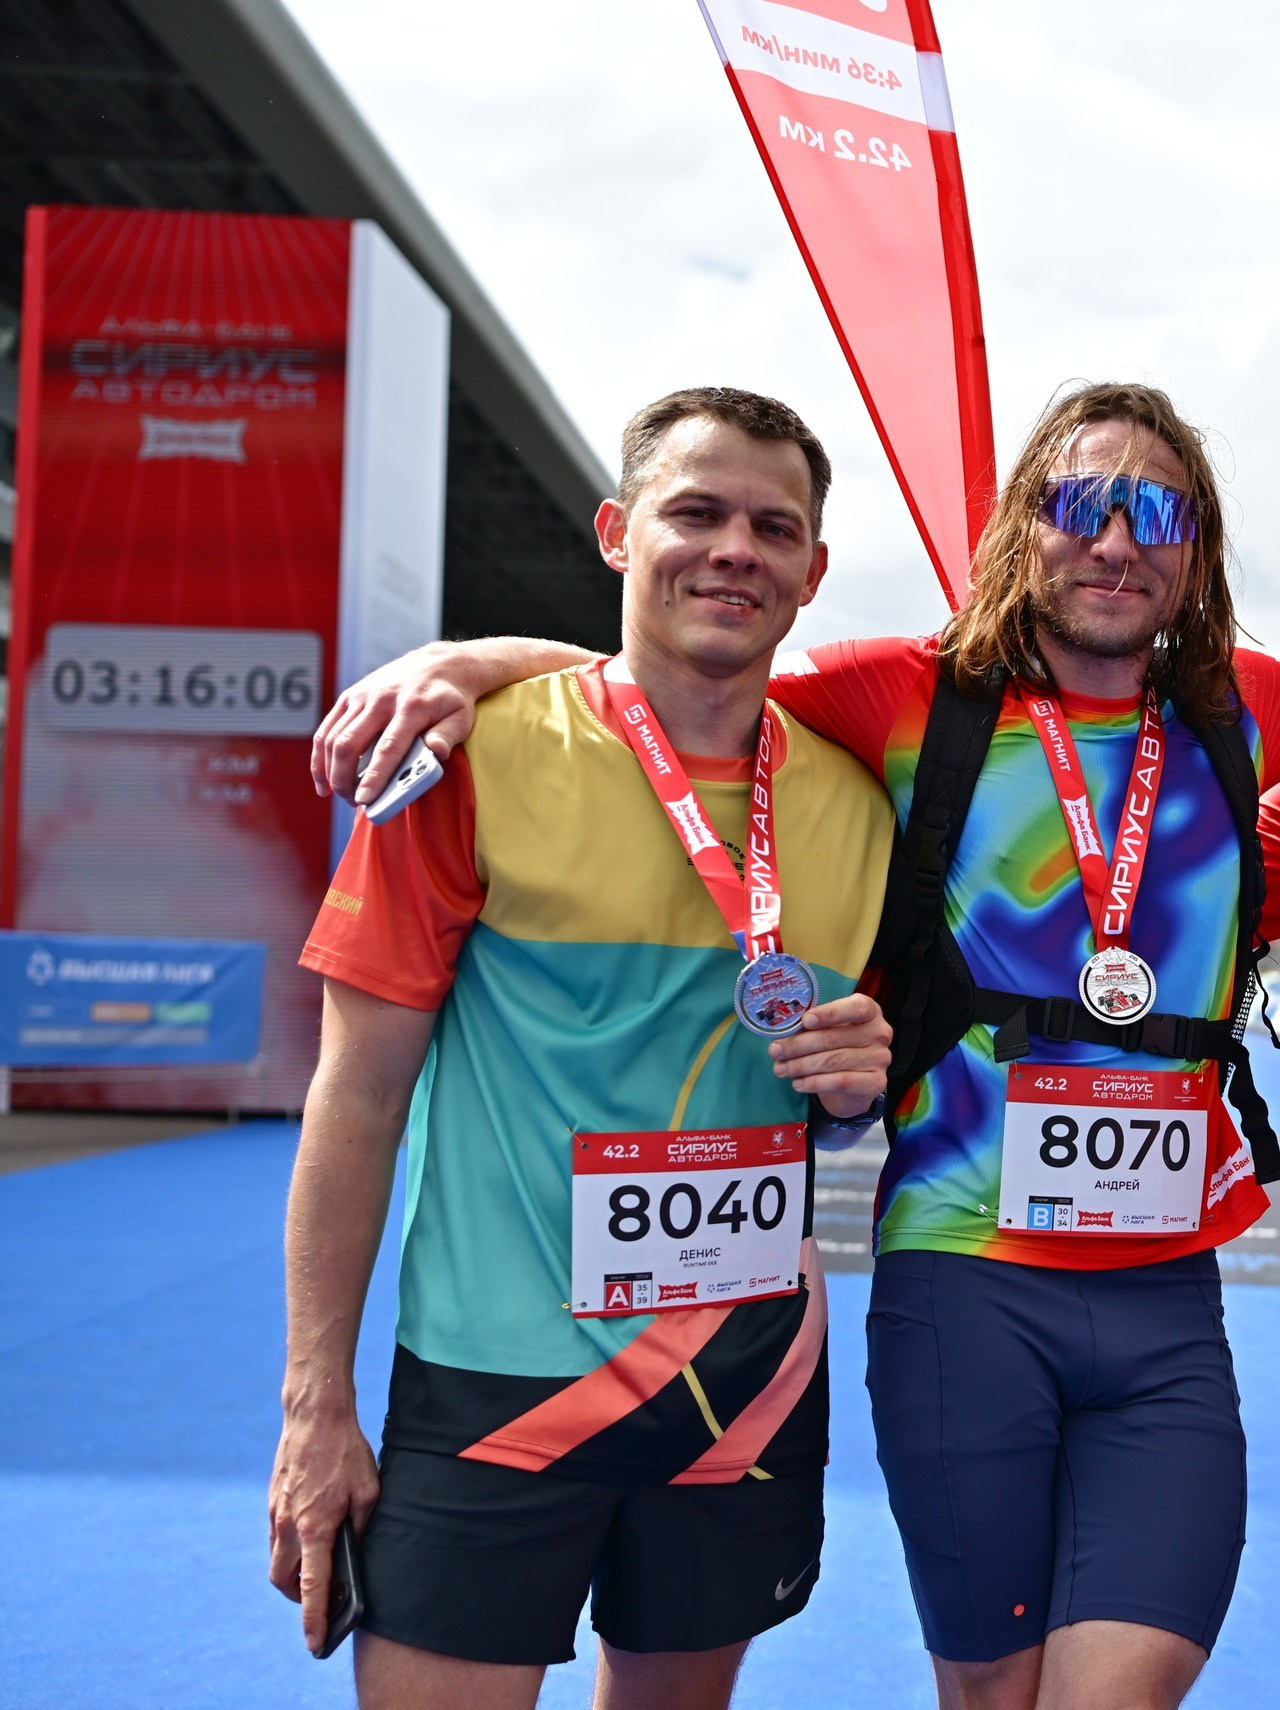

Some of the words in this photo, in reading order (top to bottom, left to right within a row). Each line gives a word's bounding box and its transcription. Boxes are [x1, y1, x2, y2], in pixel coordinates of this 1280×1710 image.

[72, 339, 318, 384] СИРИУС
[71, 379, 316, 409] АВТОДРОМ
[53, 659, 313, 711] 03:16:06
[637, 724, 672, 776] МАГНИТ
[1044, 718, 1071, 772] МАГНИТ
[1071, 804, 1085, 830] Альфа
[1081, 830, 1092, 851] Банк
[1103, 791, 1150, 935] СИРИУС
[1034, 1077, 1068, 1090] 42.2
[1100, 1074, 1149, 1082] АЛЬФА-БАНК
[1092, 1081, 1154, 1093] СИРИУС
[1092, 1092, 1153, 1100] АВТОДРОМ
[675, 1134, 732, 1142] АЛЬФА-БАНК
[1039, 1115, 1190, 1172] 8070
[602, 1144, 640, 1159] 42.2
[667, 1142, 738, 1155] СИРИУС
[668, 1153, 737, 1163] АВТОДРОМ
[1094, 1179, 1140, 1192] АНДРЕЙ
[608, 1175, 787, 1242] 8040
[679, 1247, 722, 1262] ДЕНИС
[636, 1283, 648, 1292] 35
[757, 1275, 781, 1285] МАГНИТ
